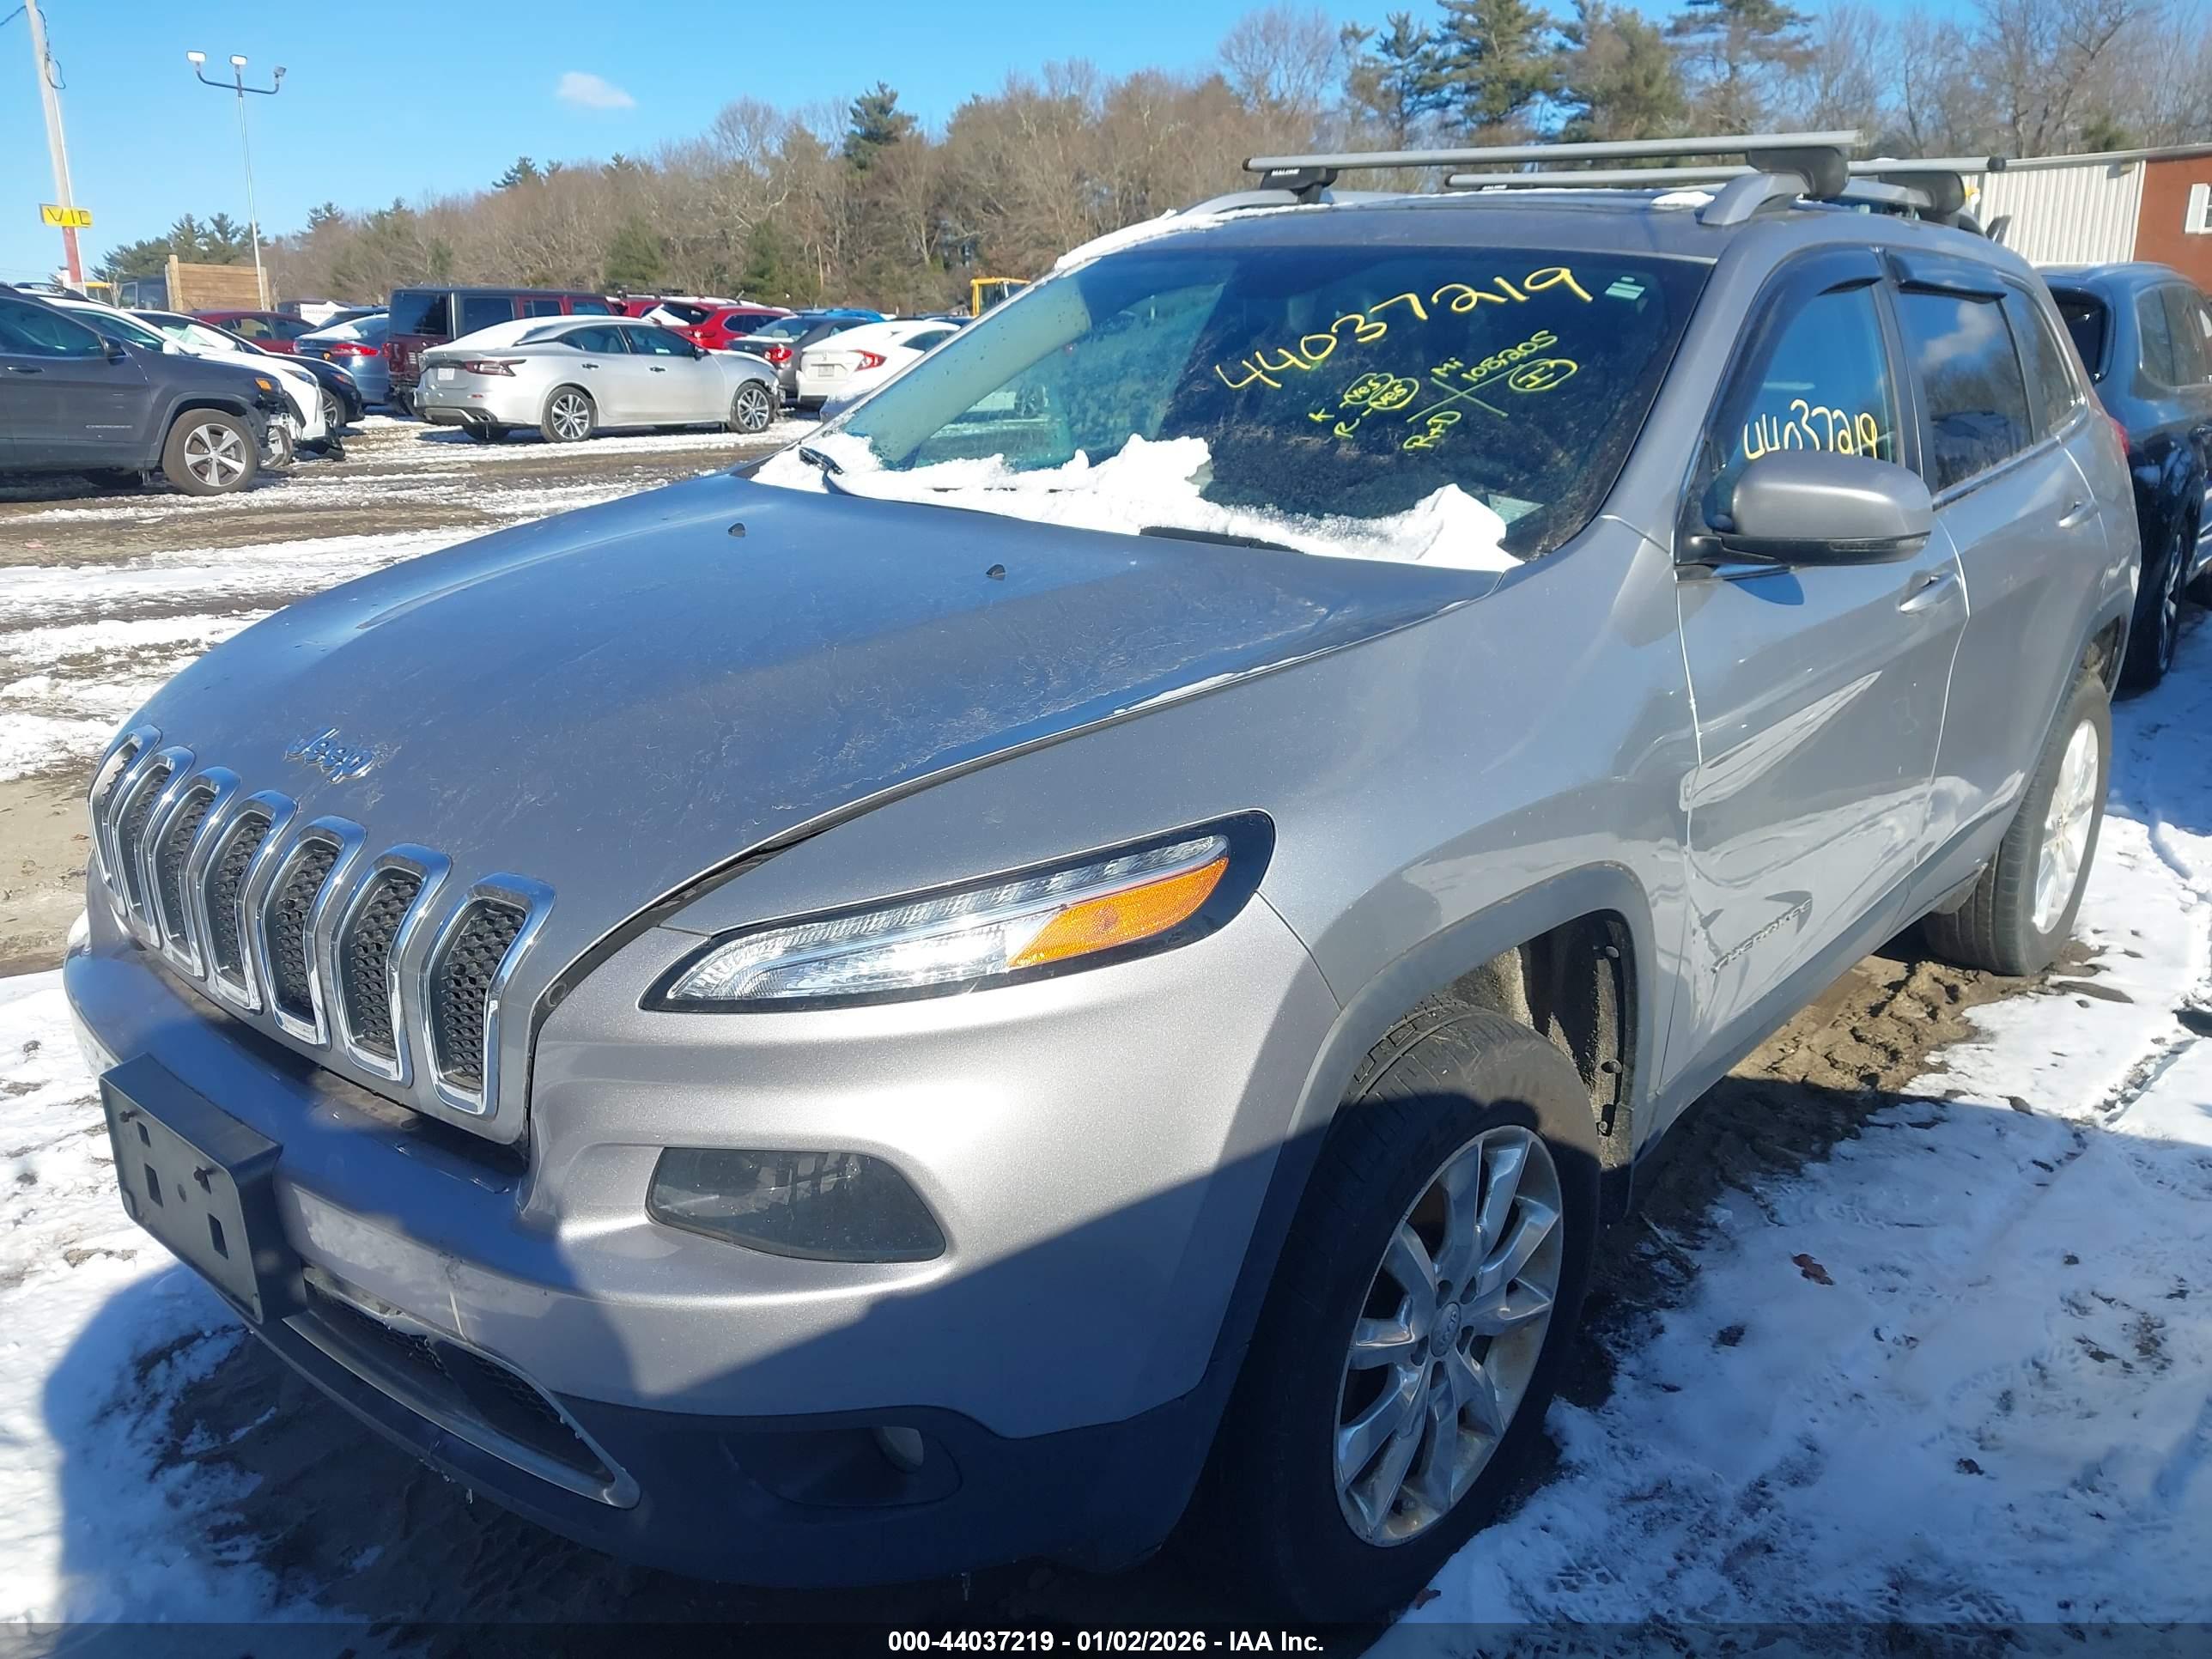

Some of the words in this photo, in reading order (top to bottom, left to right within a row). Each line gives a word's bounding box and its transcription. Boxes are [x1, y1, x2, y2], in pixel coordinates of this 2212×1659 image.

[1214, 267, 1594, 389] 44037219
[1334, 417, 1360, 440] R
[1743, 398, 1878, 460] 44037219
[283, 727, 375, 784] Jeep
